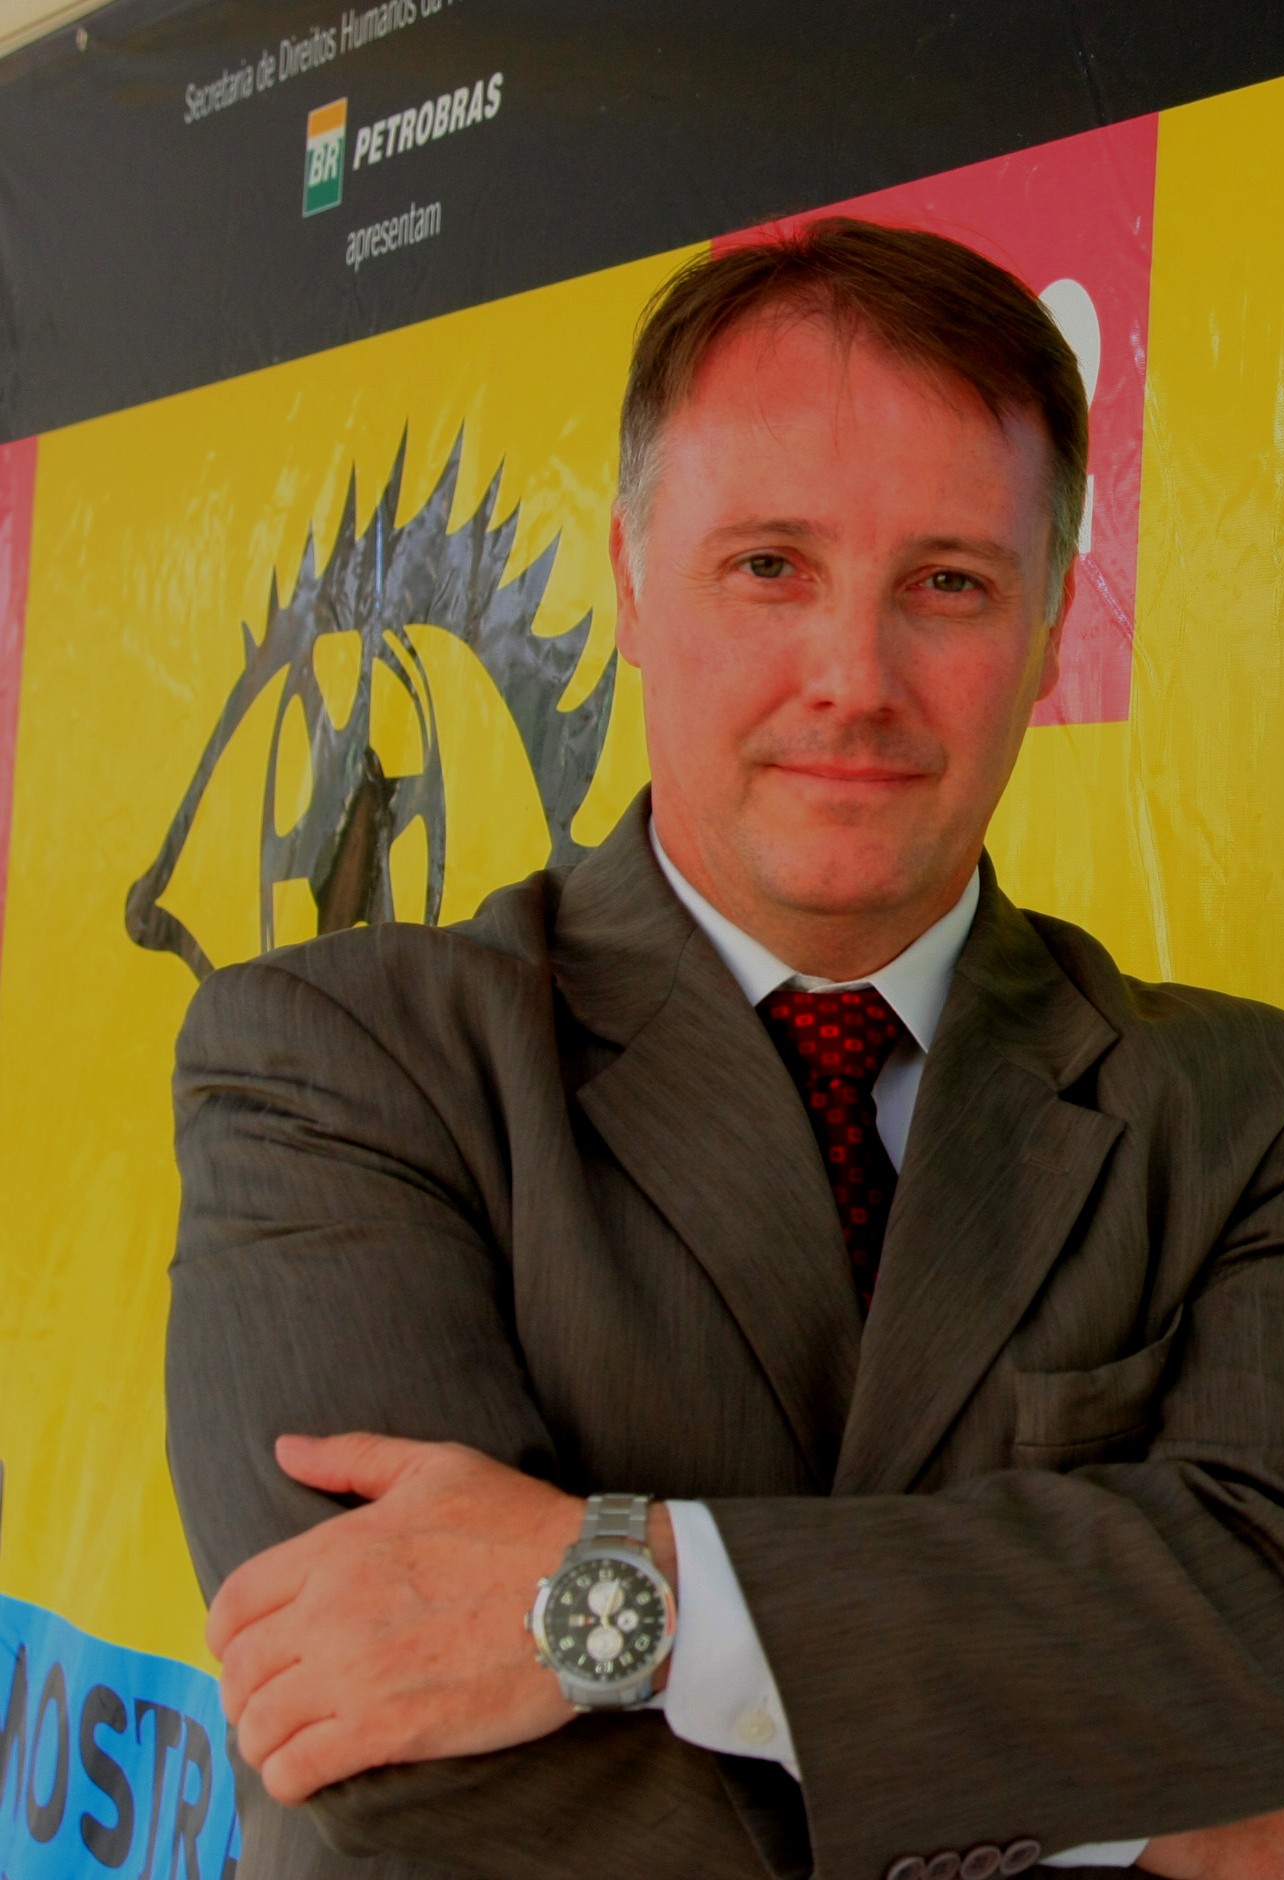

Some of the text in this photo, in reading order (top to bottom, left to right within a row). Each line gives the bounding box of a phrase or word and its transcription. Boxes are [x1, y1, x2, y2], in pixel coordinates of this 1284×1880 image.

[184, 0, 417, 124] Secretaria de Direitos Humanos
[308, 72, 504, 188] BR PETROBRAS
[345, 202, 442, 273] apresentam
[0, 1641, 242, 1880] OSTR
